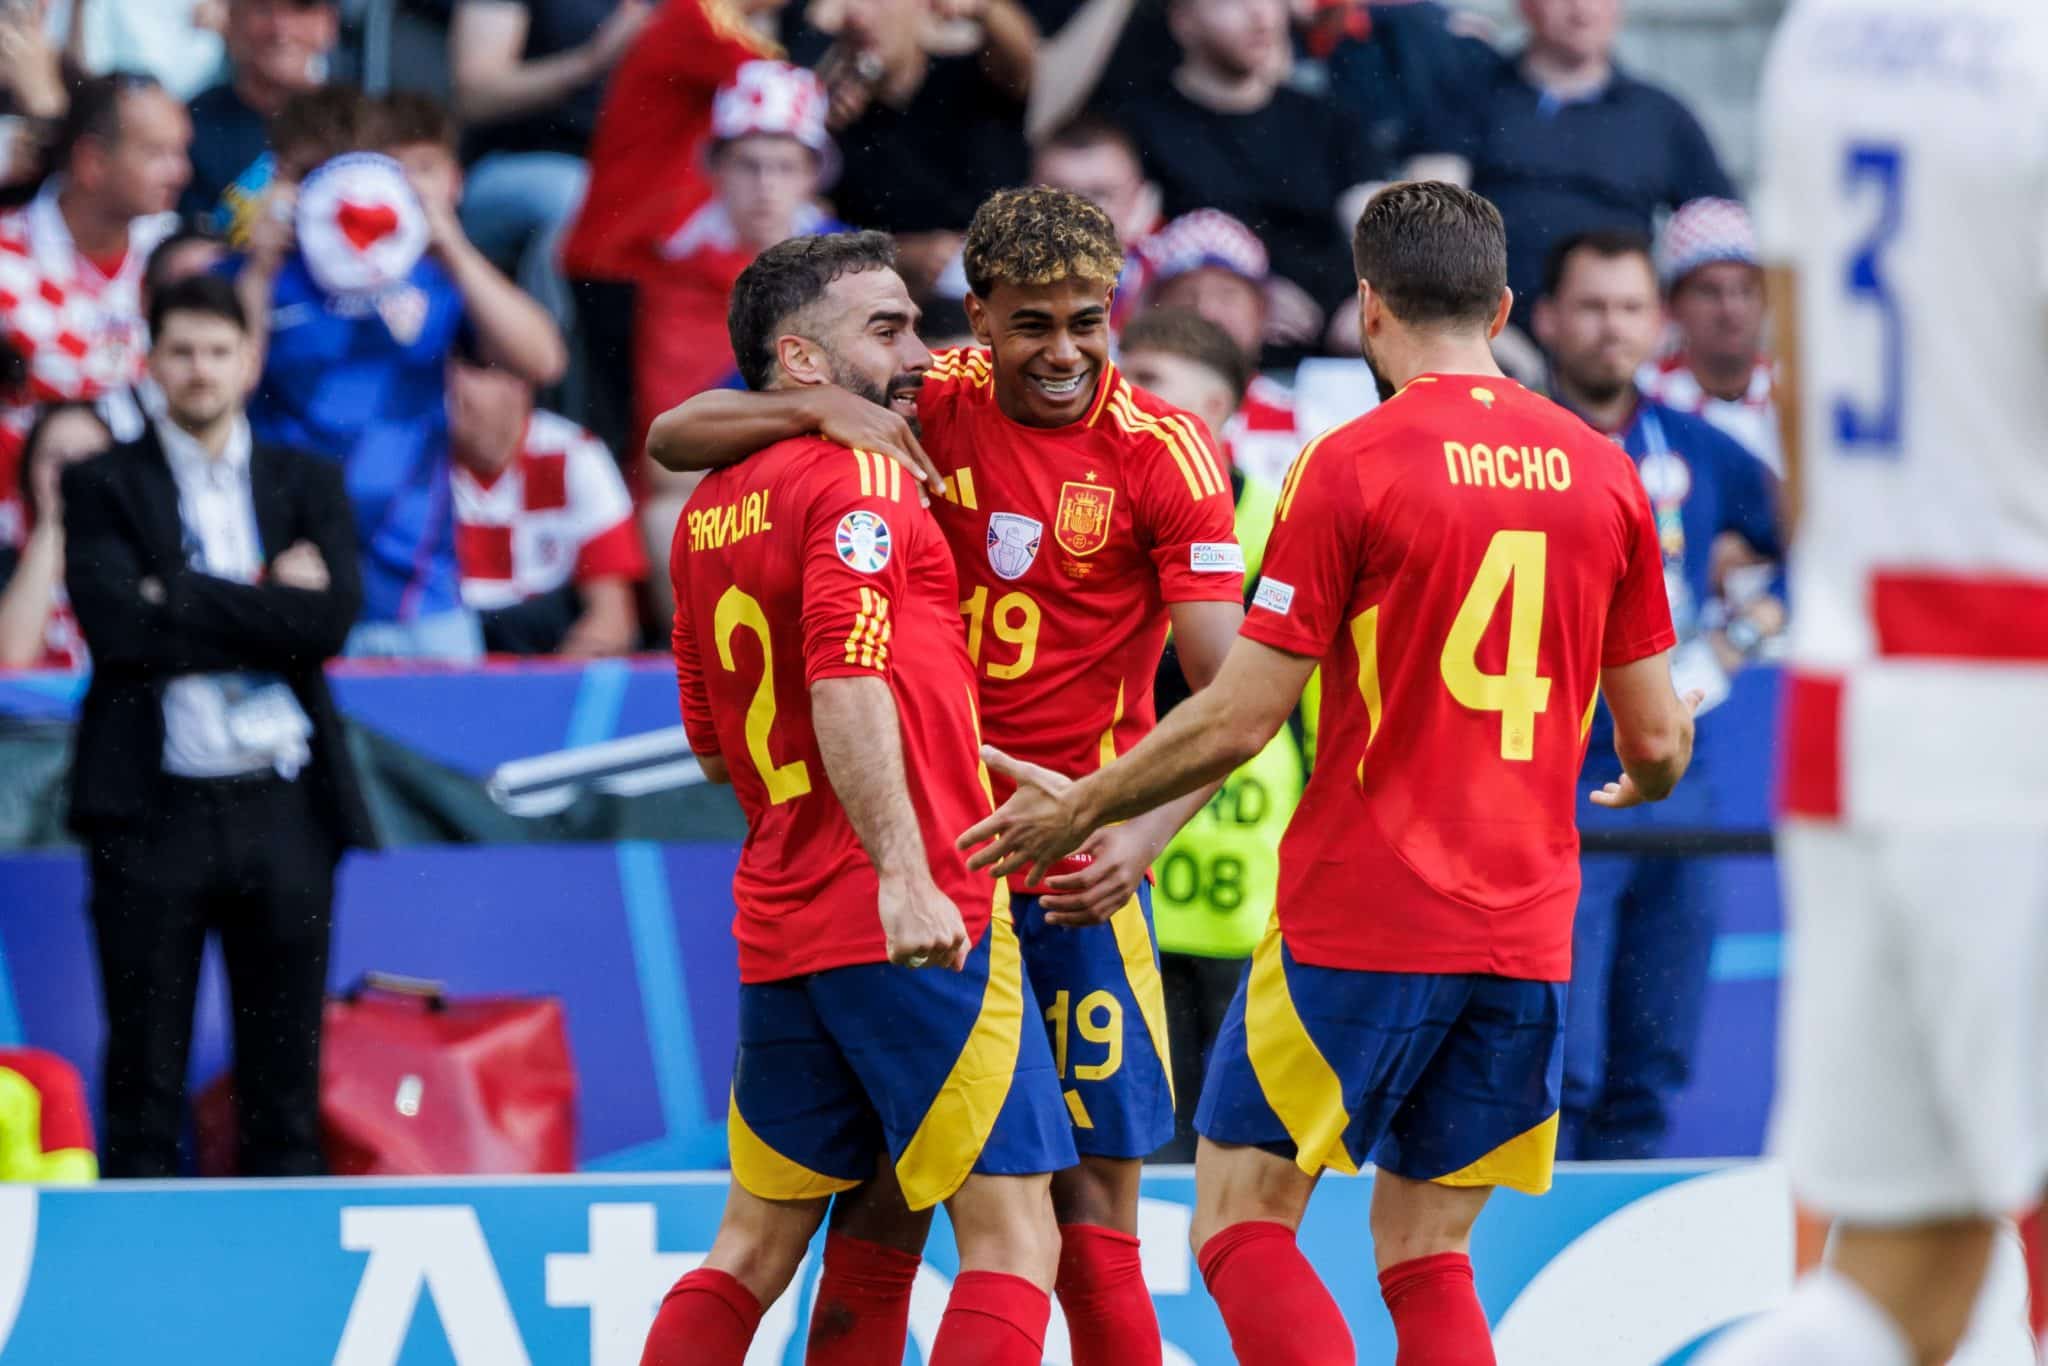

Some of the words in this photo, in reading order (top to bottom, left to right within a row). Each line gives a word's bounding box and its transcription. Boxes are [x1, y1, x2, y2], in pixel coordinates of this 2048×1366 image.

[1833, 142, 1905, 456] 3
[1443, 440, 1572, 493] NACHO
[688, 488, 772, 552] ARVAJAL
[960, 585, 1042, 680] 19
[1440, 529, 1553, 761] 4
[714, 584, 812, 806] 2
[1161, 850, 1244, 914] 08
[1045, 990, 1123, 1080] 19
